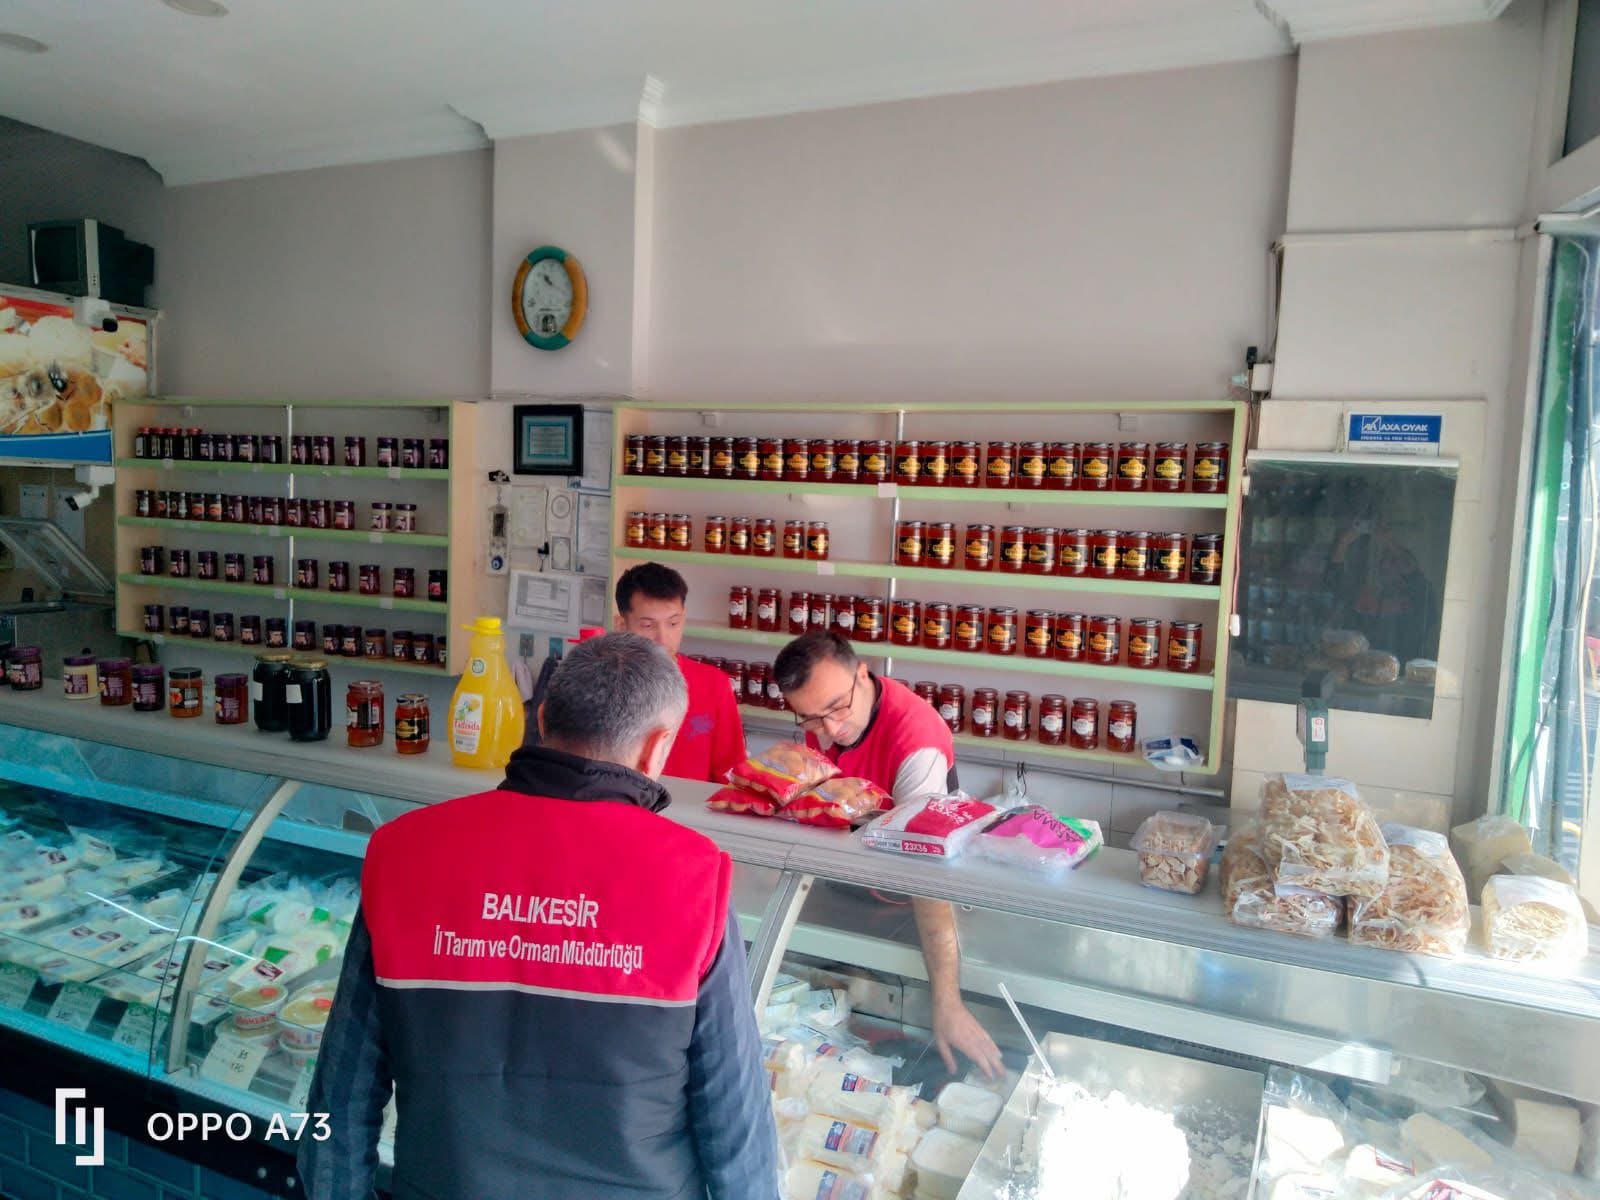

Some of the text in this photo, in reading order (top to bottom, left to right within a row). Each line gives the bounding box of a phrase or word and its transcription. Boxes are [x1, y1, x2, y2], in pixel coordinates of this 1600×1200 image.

[1401, 423, 1428, 432] OYAK
[482, 892, 599, 929] BALIKESİR
[444, 931, 486, 958] Tarım
[488, 939, 506, 958] ve
[508, 934, 560, 963] Orman
[560, 939, 643, 974] Müdürlüğü
